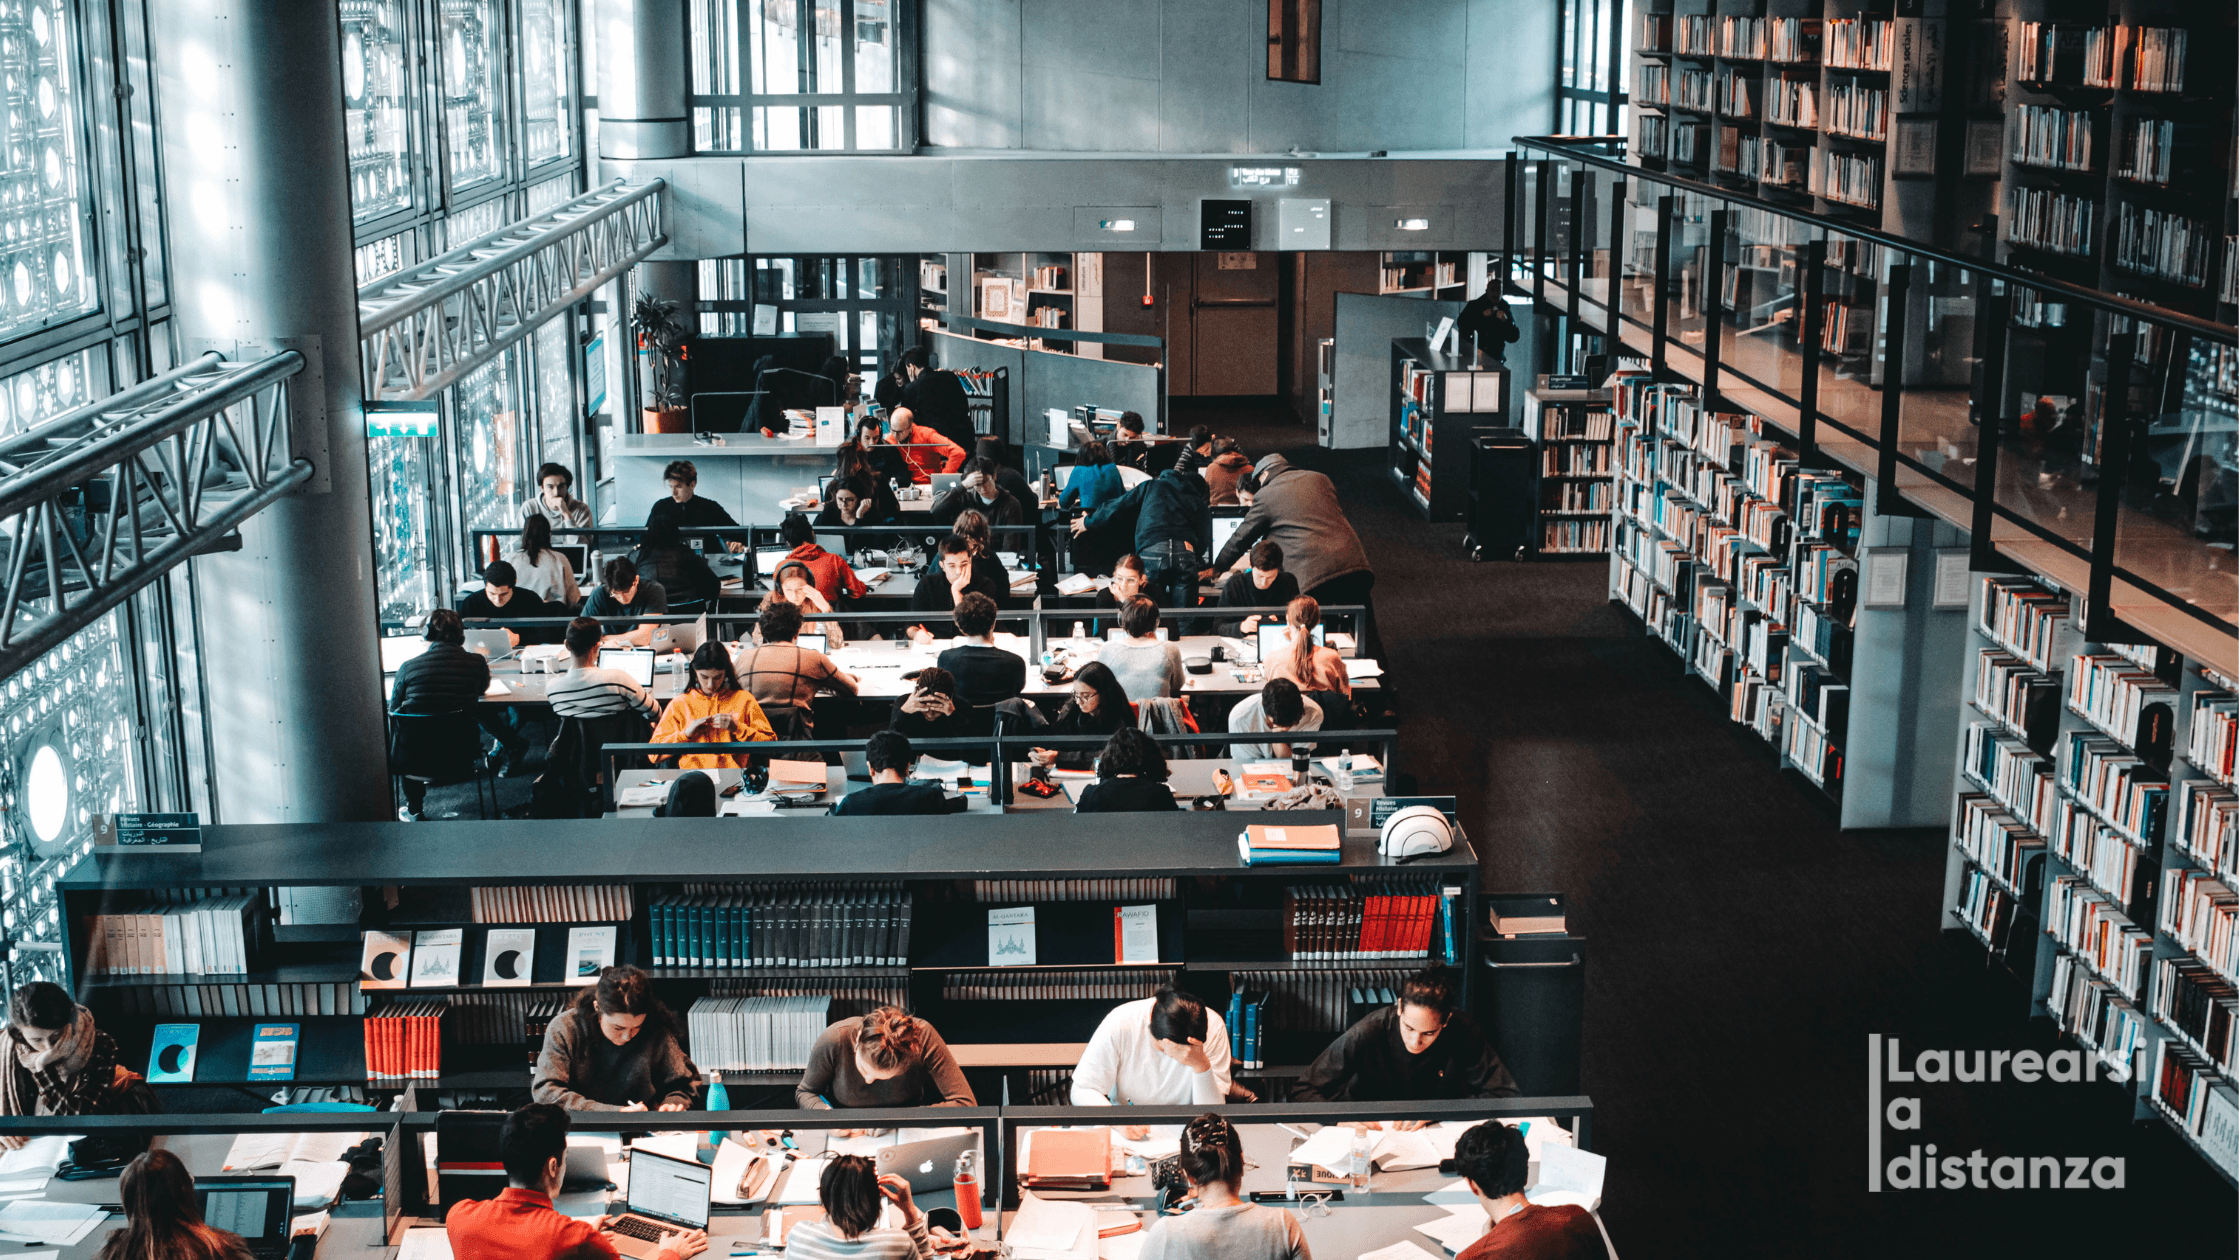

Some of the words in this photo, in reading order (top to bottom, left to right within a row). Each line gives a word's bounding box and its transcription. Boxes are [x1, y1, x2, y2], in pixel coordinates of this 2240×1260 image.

[1903, 23, 1912, 61] sociales
[1899, 63, 1911, 104] Sciences
[1354, 808, 1363, 819] 9
[100, 825, 108, 835] 9
[147, 821, 180, 829] Géographie
